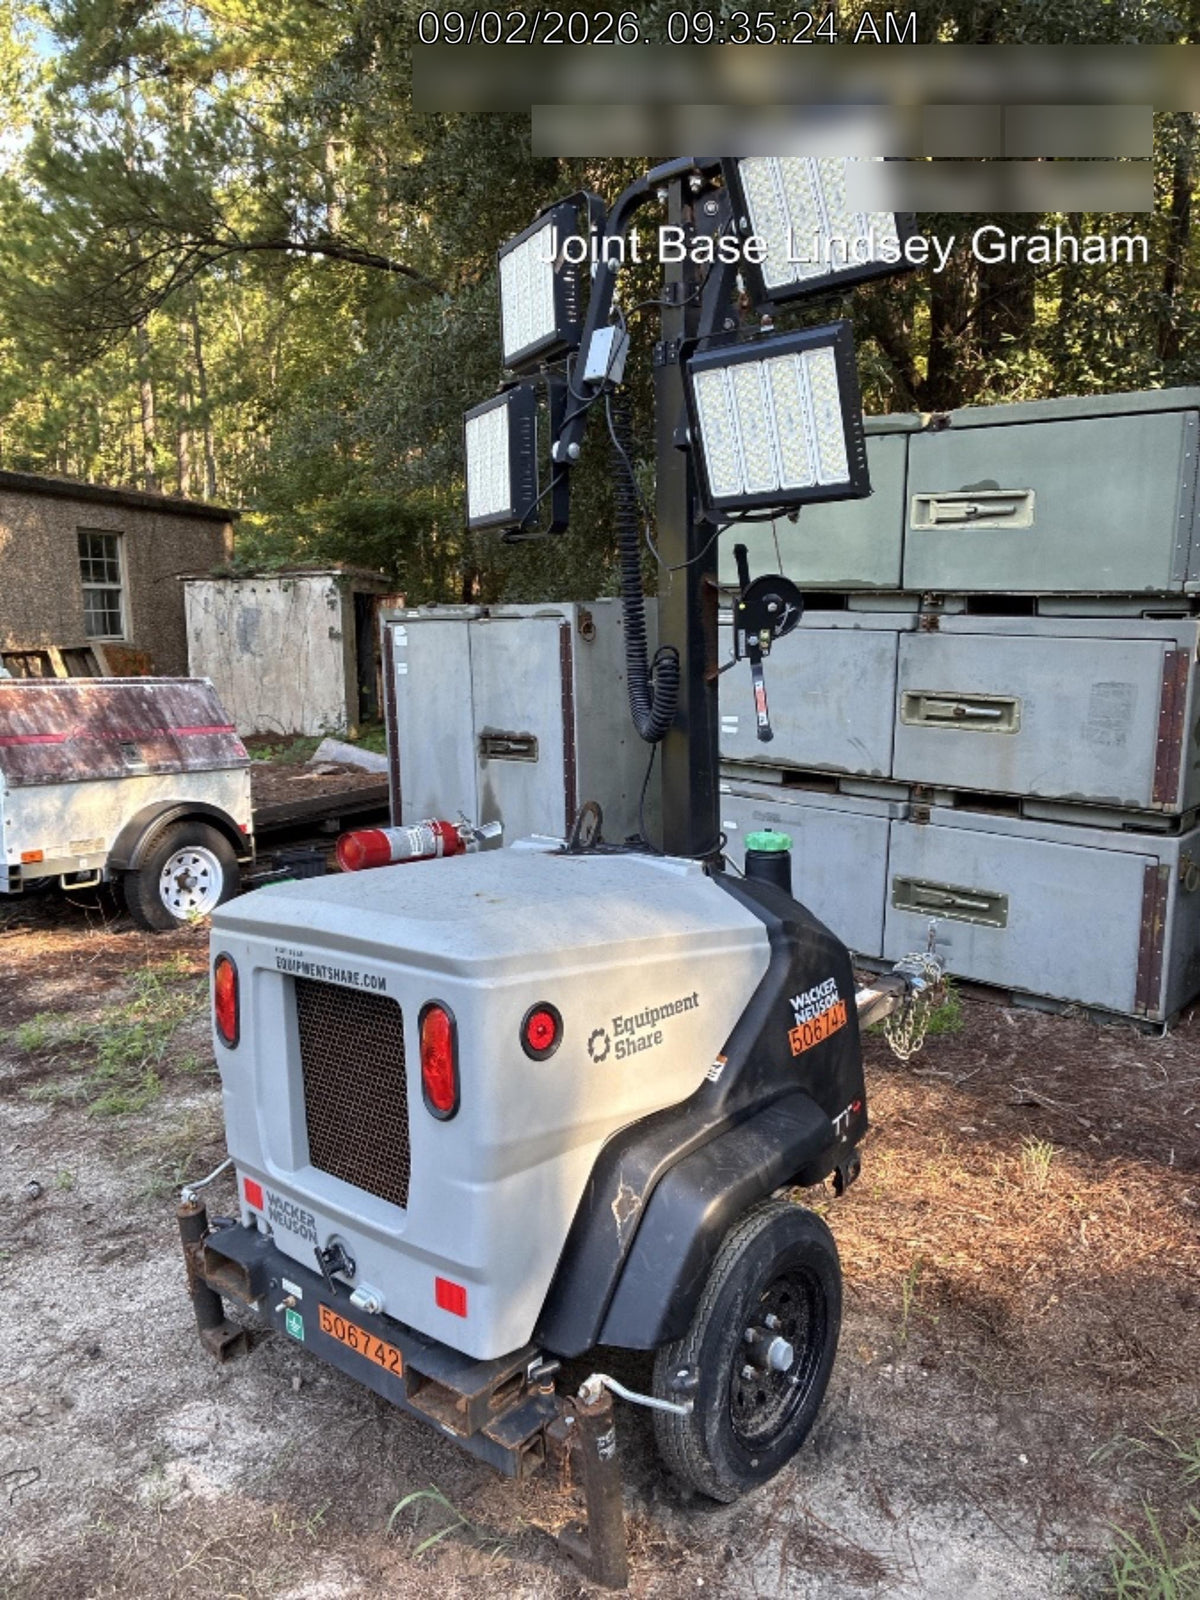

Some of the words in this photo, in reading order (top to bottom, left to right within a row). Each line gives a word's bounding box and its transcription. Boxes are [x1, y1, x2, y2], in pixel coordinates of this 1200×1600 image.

[276, 956, 387, 991] EQUIPMENTSHARE.COM
[789, 977, 838, 1011] WACKER
[794, 990, 840, 1027] NEUSON
[611, 991, 699, 1037] Equipment
[614, 1030, 663, 1060] Share
[266, 1190, 317, 1231] WACKER
[268, 1206, 318, 1245] NEUSON
[322, 1315, 399, 1374] 506742
